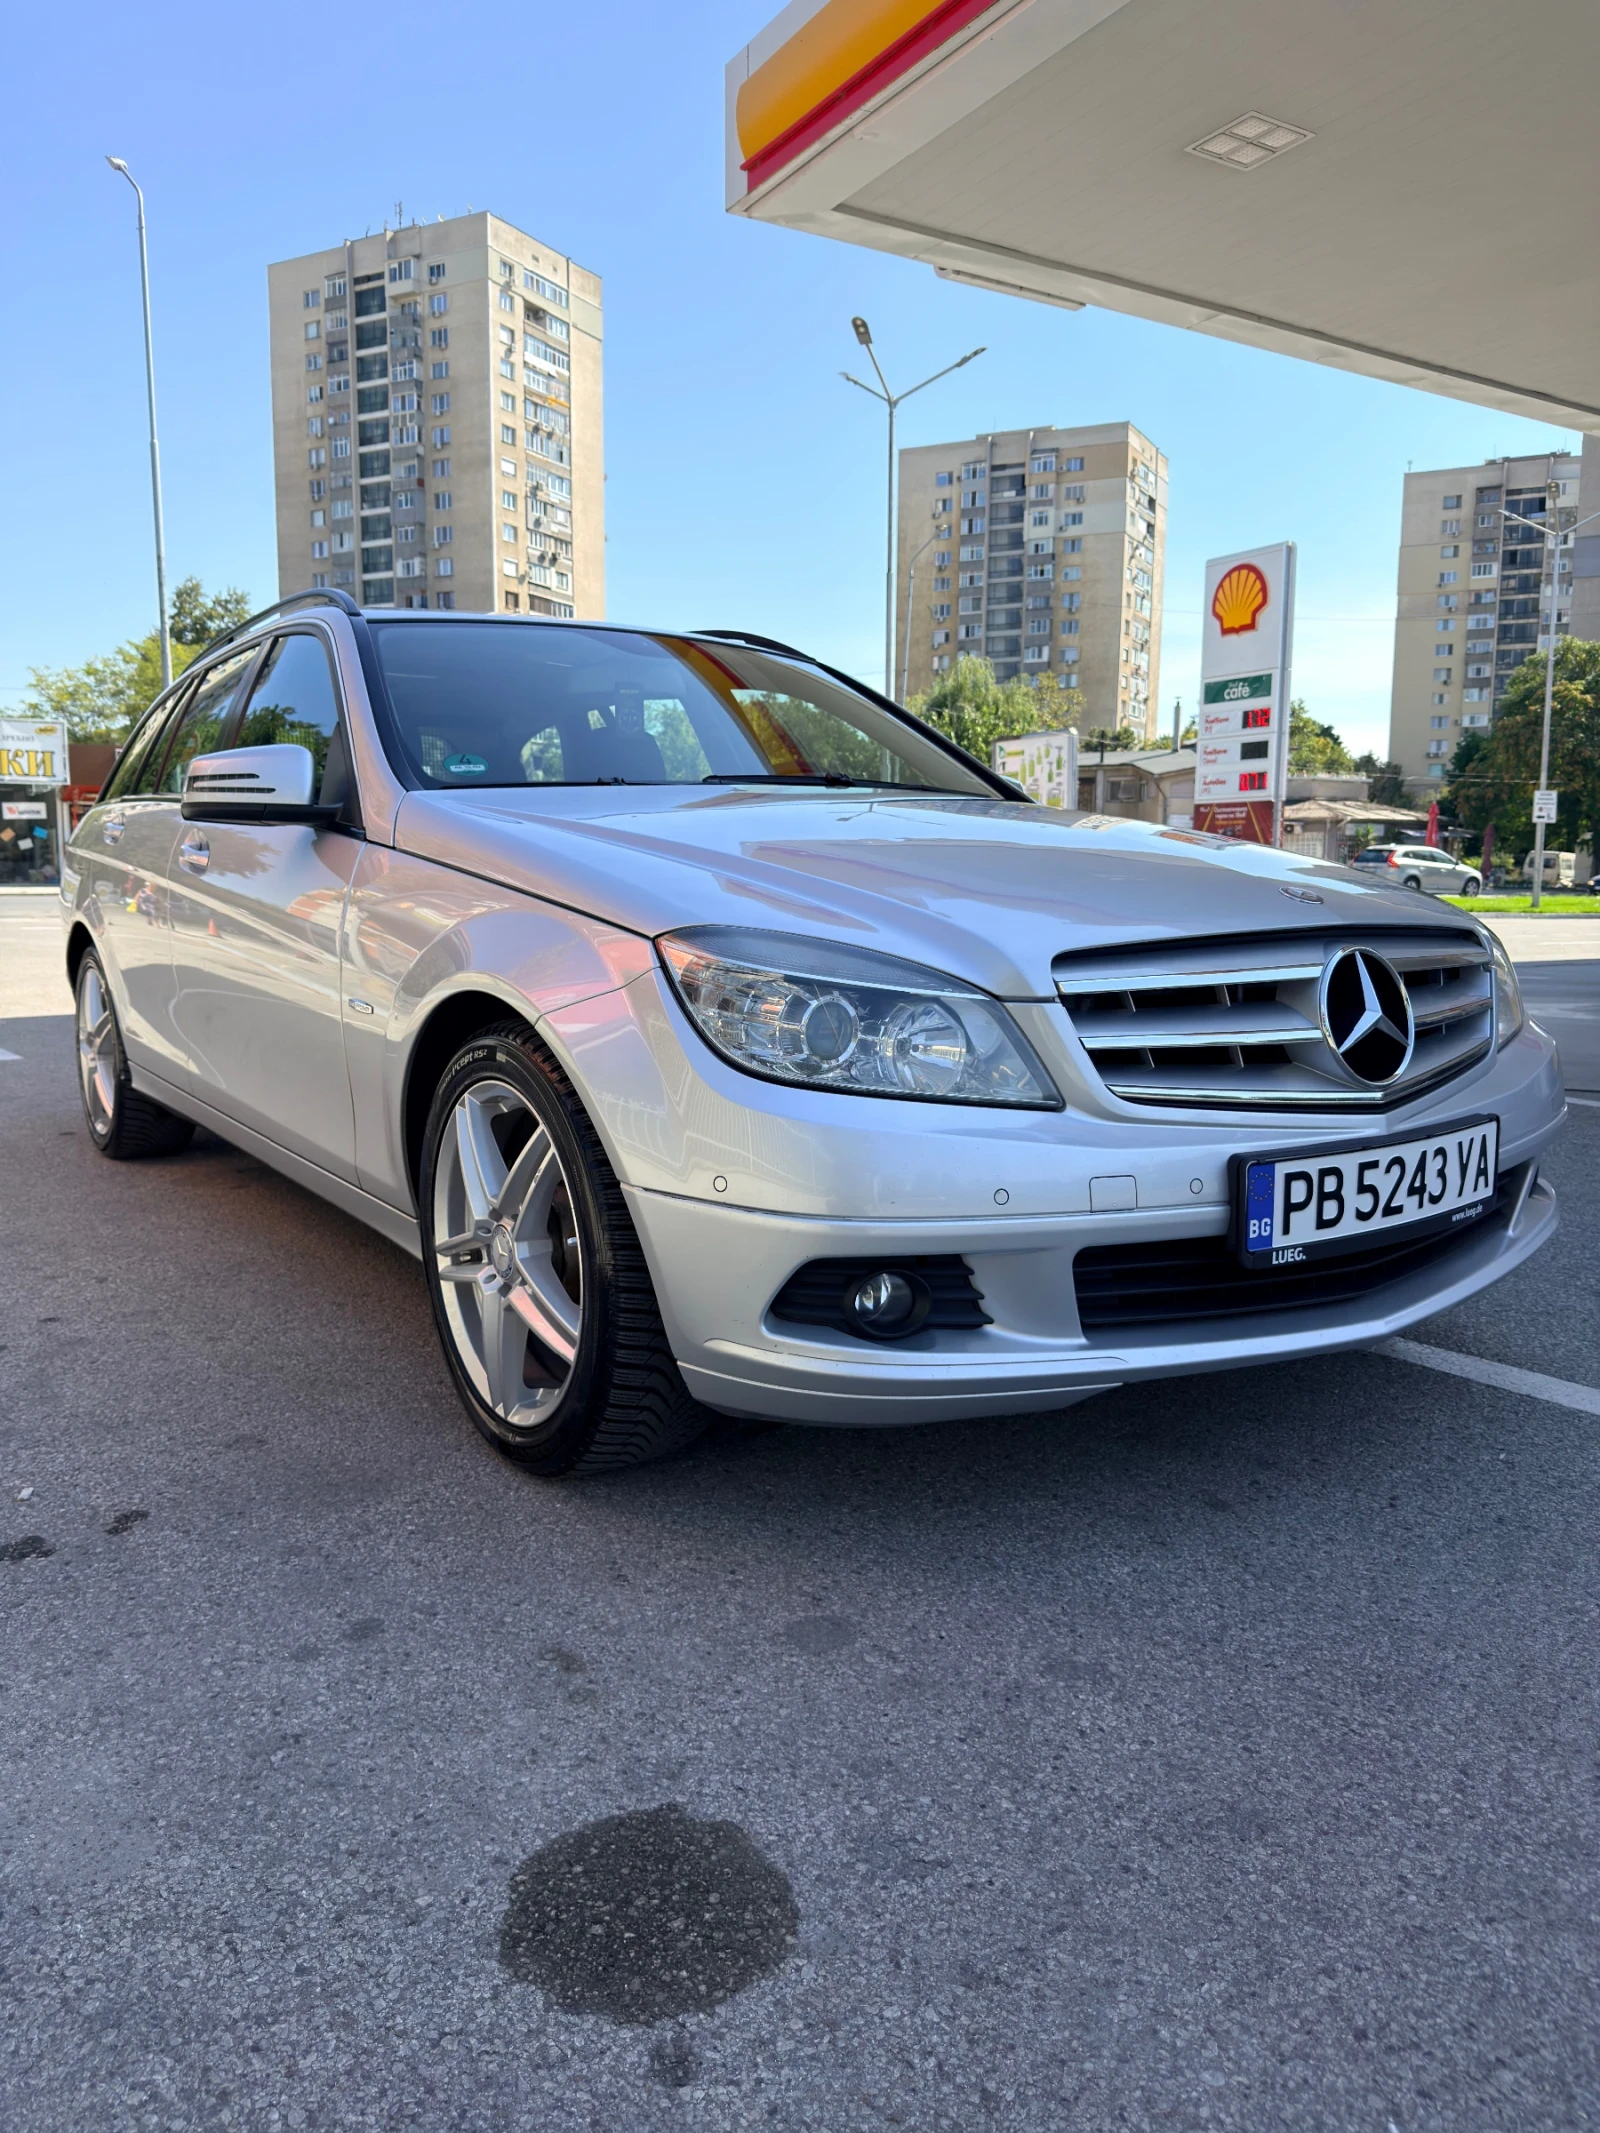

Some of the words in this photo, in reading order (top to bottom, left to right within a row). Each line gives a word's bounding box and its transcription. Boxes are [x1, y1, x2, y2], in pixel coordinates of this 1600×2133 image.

[1224, 682, 1250, 700] café
[1282, 1166, 1344, 1236] PB
[1355, 1146, 1448, 1222] 5243
[1457, 1133, 1489, 1198] YA
[1451, 1204, 1483, 1222] www.lueg.de
[1249, 1218, 1271, 1238] BG
[1272, 1247, 1306, 1265] LUEG.
